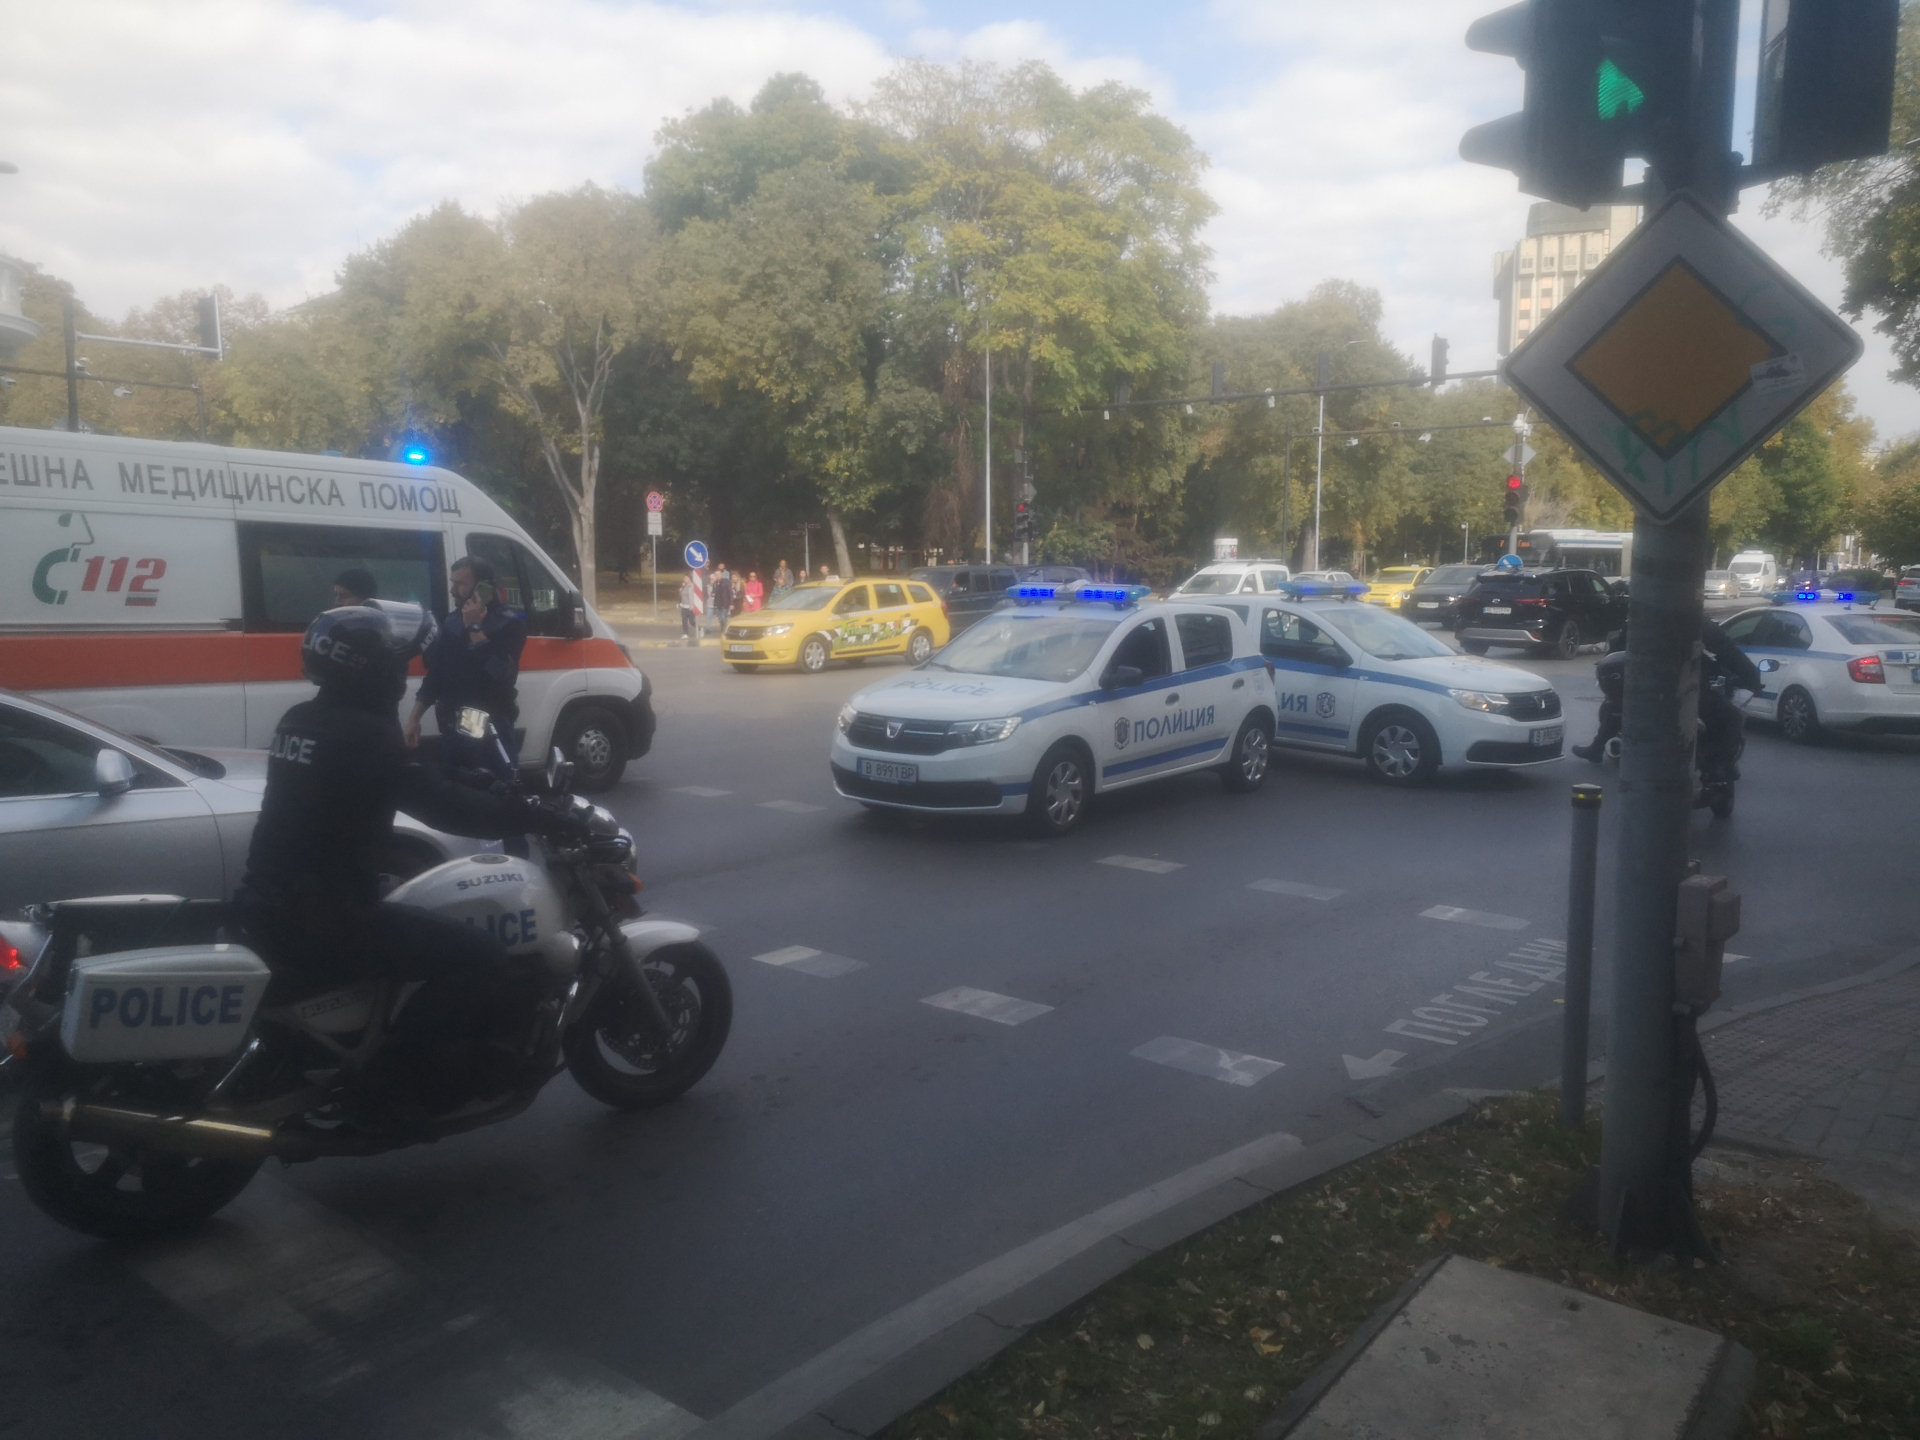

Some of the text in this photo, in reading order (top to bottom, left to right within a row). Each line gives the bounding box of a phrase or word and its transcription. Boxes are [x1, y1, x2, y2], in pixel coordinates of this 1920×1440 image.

[118, 461, 345, 507] МЕДИЦИНСКА
[359, 480, 462, 518] ПОМОЩ
[81, 555, 167, 593] 112
[892, 681, 995, 697] POLICE
[1133, 704, 1215, 743] ПОЛИЦИЯ
[456, 873, 524, 891] SUZUKI
[90, 985, 245, 1029] POLICE
